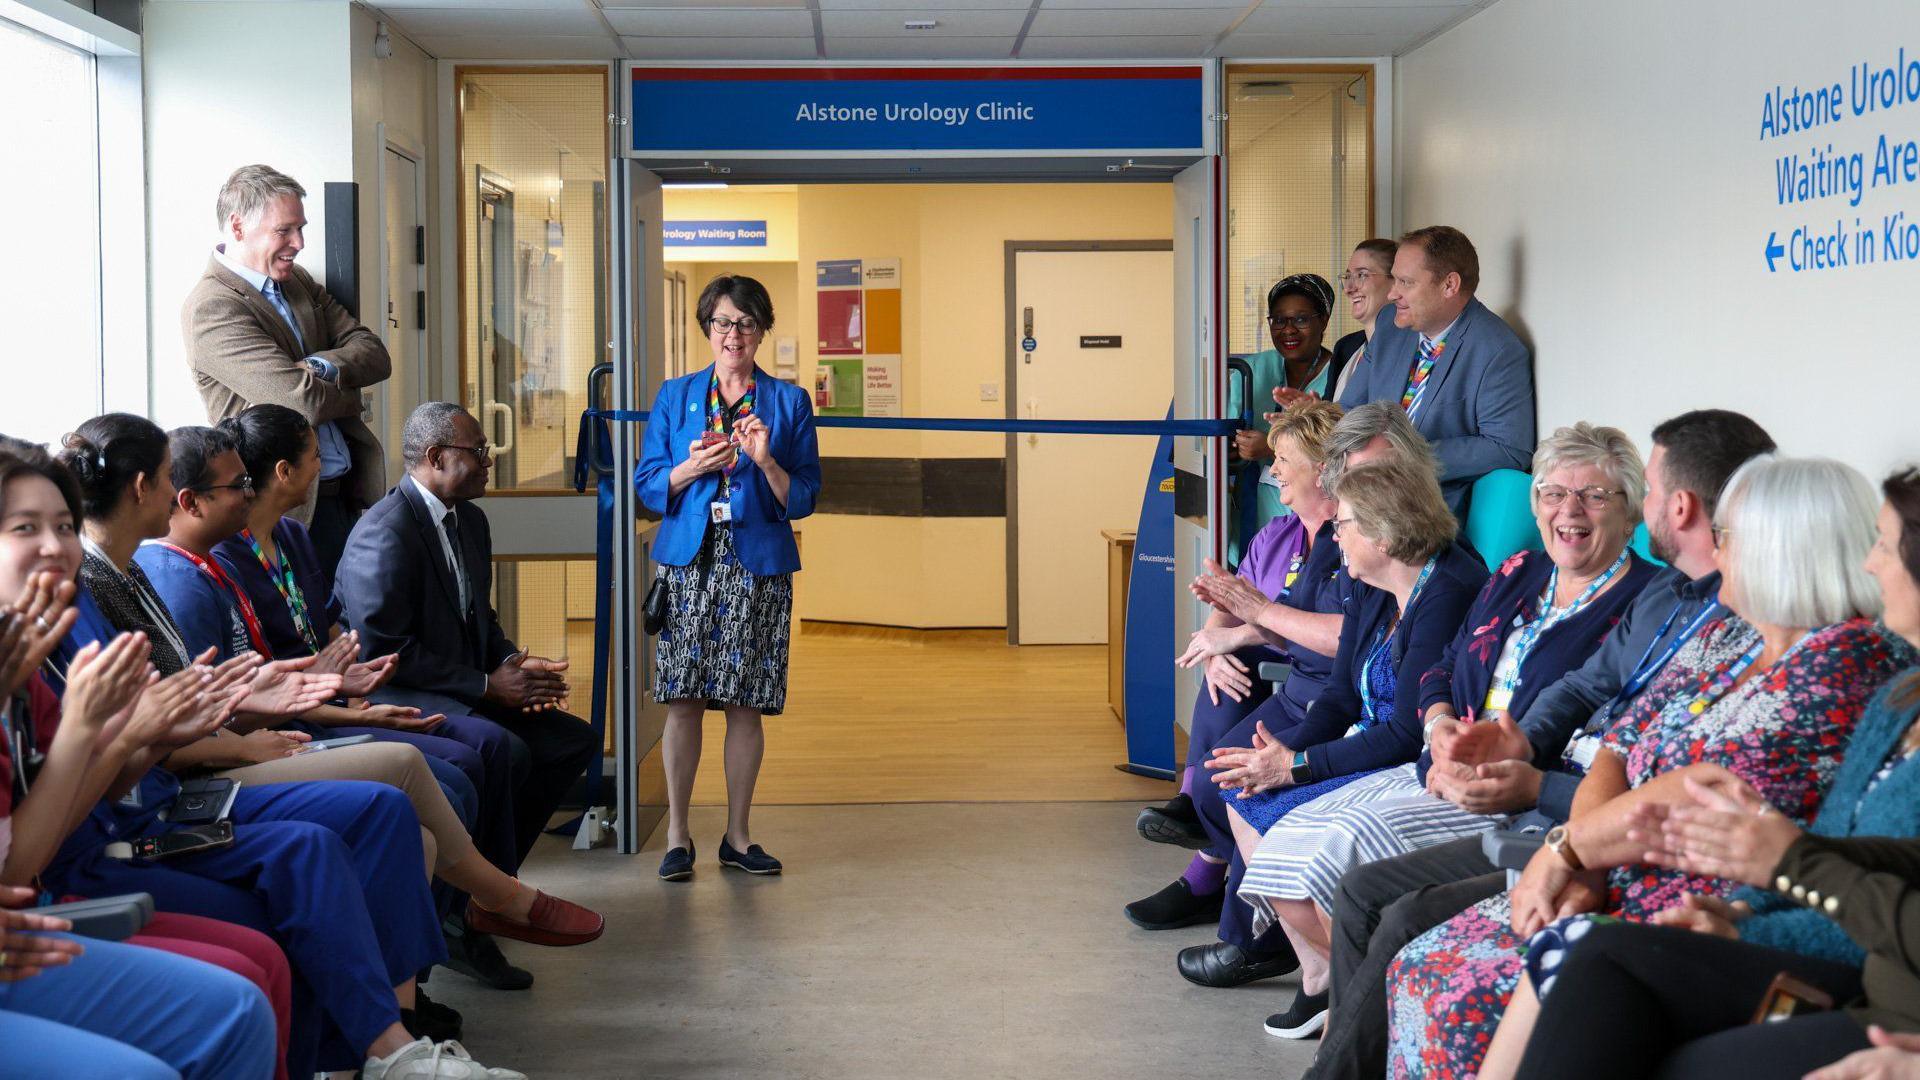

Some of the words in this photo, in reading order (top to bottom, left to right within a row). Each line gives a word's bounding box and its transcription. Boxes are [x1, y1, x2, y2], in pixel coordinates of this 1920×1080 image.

[1759, 83, 1843, 141] Alstone
[1852, 47, 1920, 117] Urolo
[796, 102, 878, 121] Alstone
[885, 102, 969, 125] Urology
[976, 102, 1034, 121] Clinic
[1775, 143, 1864, 207] Waiting
[1872, 134, 1920, 188] Are
[698, 229, 736, 241] Waiting
[738, 229, 765, 239] Room
[1790, 219, 1848, 272] Check
[1855, 217, 1875, 265] in
[1883, 210, 1920, 262] Kio
[867, 366, 886, 374] Making
[1609, 561, 1622, 574] NHS
[1593, 574, 1608, 588] NHS
